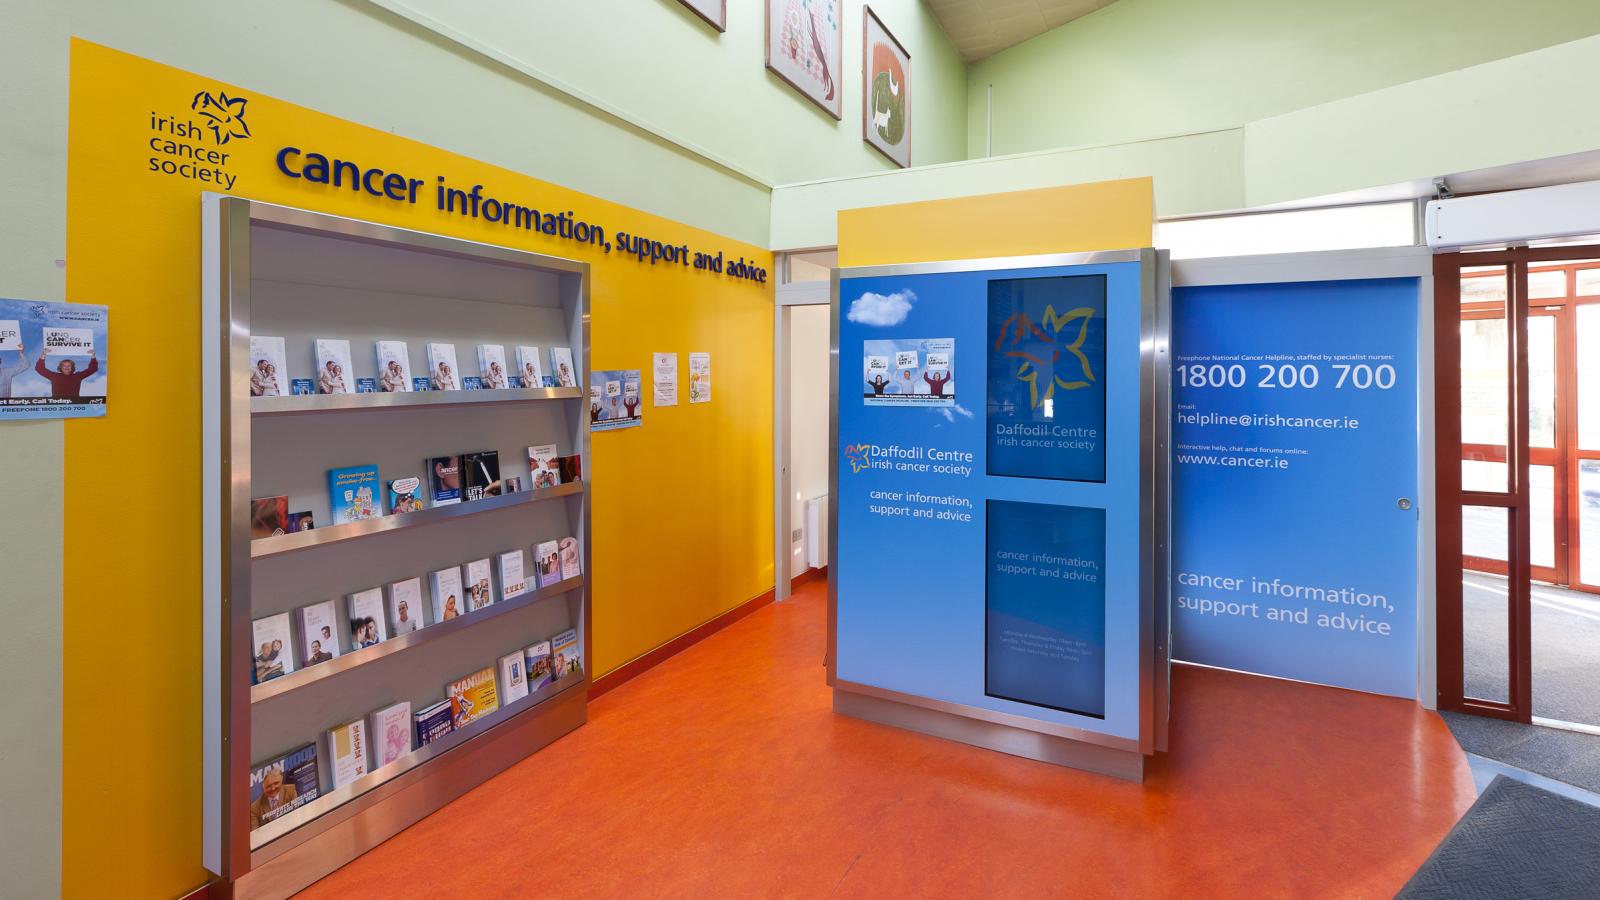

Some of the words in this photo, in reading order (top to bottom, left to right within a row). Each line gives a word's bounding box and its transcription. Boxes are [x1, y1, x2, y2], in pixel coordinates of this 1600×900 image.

[151, 112, 202, 141] irish
[149, 137, 230, 166] cancer
[149, 157, 237, 190] society
[276, 146, 424, 204] cancer
[437, 176, 612, 253] information,
[616, 230, 689, 267] support
[693, 252, 723, 274] and
[726, 258, 767, 284] advice
[1177, 364, 1246, 388] 1800
[1258, 364, 1319, 389] 200
[1332, 364, 1396, 390] 700
[1177, 412, 1359, 429] helpline@irishcancer.ie
[996, 424, 1048, 436] Daffodil
[1052, 425, 1097, 438] Centre
[871, 444, 923, 460] Daffodil
[927, 448, 973, 462] Centre
[997, 436, 1017, 447] irish
[1021, 439, 1054, 448] cancer
[1057, 438, 1095, 451] society
[1212, 445, 1228, 453] help,
[871, 459, 893, 470] irish
[895, 463, 930, 473] cancer
[933, 463, 972, 477] society
[1177, 453, 1288, 469] www.cancer.ie
[870, 490, 903, 501] cancer
[906, 491, 973, 509] information,
[870, 504, 910, 517] support
[913, 506, 933, 518] and
[936, 508, 971, 522] advice
[997, 551, 1029, 561] cancer
[1032, 552, 1098, 570] information,
[996, 563, 1036, 575] support
[1040, 568, 1060, 578] and
[1063, 570, 1097, 582] advice
[1178, 571, 1244, 591] cancer
[1252, 576, 1394, 613] information,
[1177, 595, 1259, 619] support
[1266, 607, 1308, 624] and
[1316, 612, 1391, 636] advice
